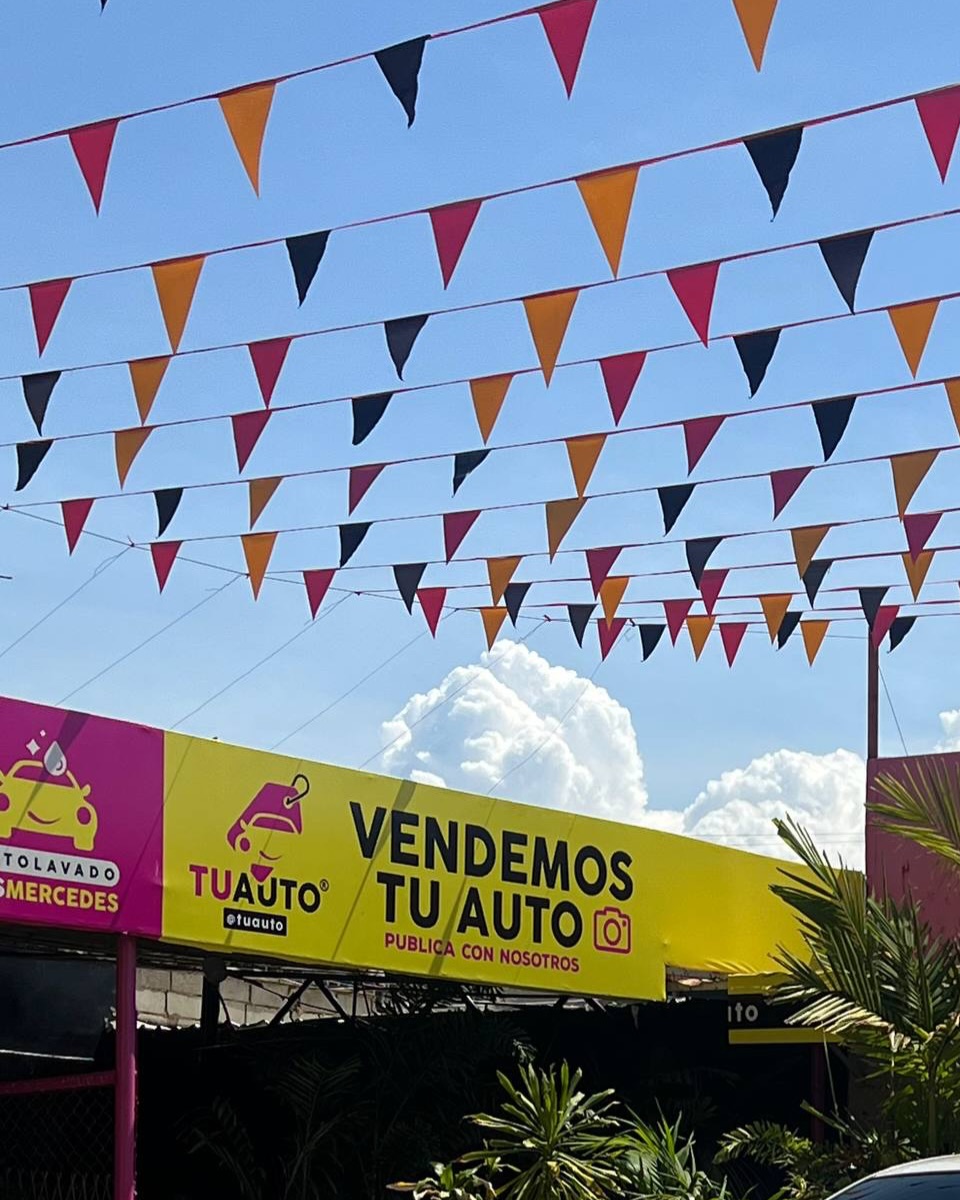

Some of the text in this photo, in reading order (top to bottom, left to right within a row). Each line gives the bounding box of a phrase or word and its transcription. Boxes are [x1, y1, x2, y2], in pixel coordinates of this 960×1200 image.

[349, 801, 634, 902] VENDEMOS
[226, 913, 284, 932] @tuauto
[376, 871, 583, 948] TU AUTO
[385, 932, 580, 973] PUBLICA CON NOSOTROS
